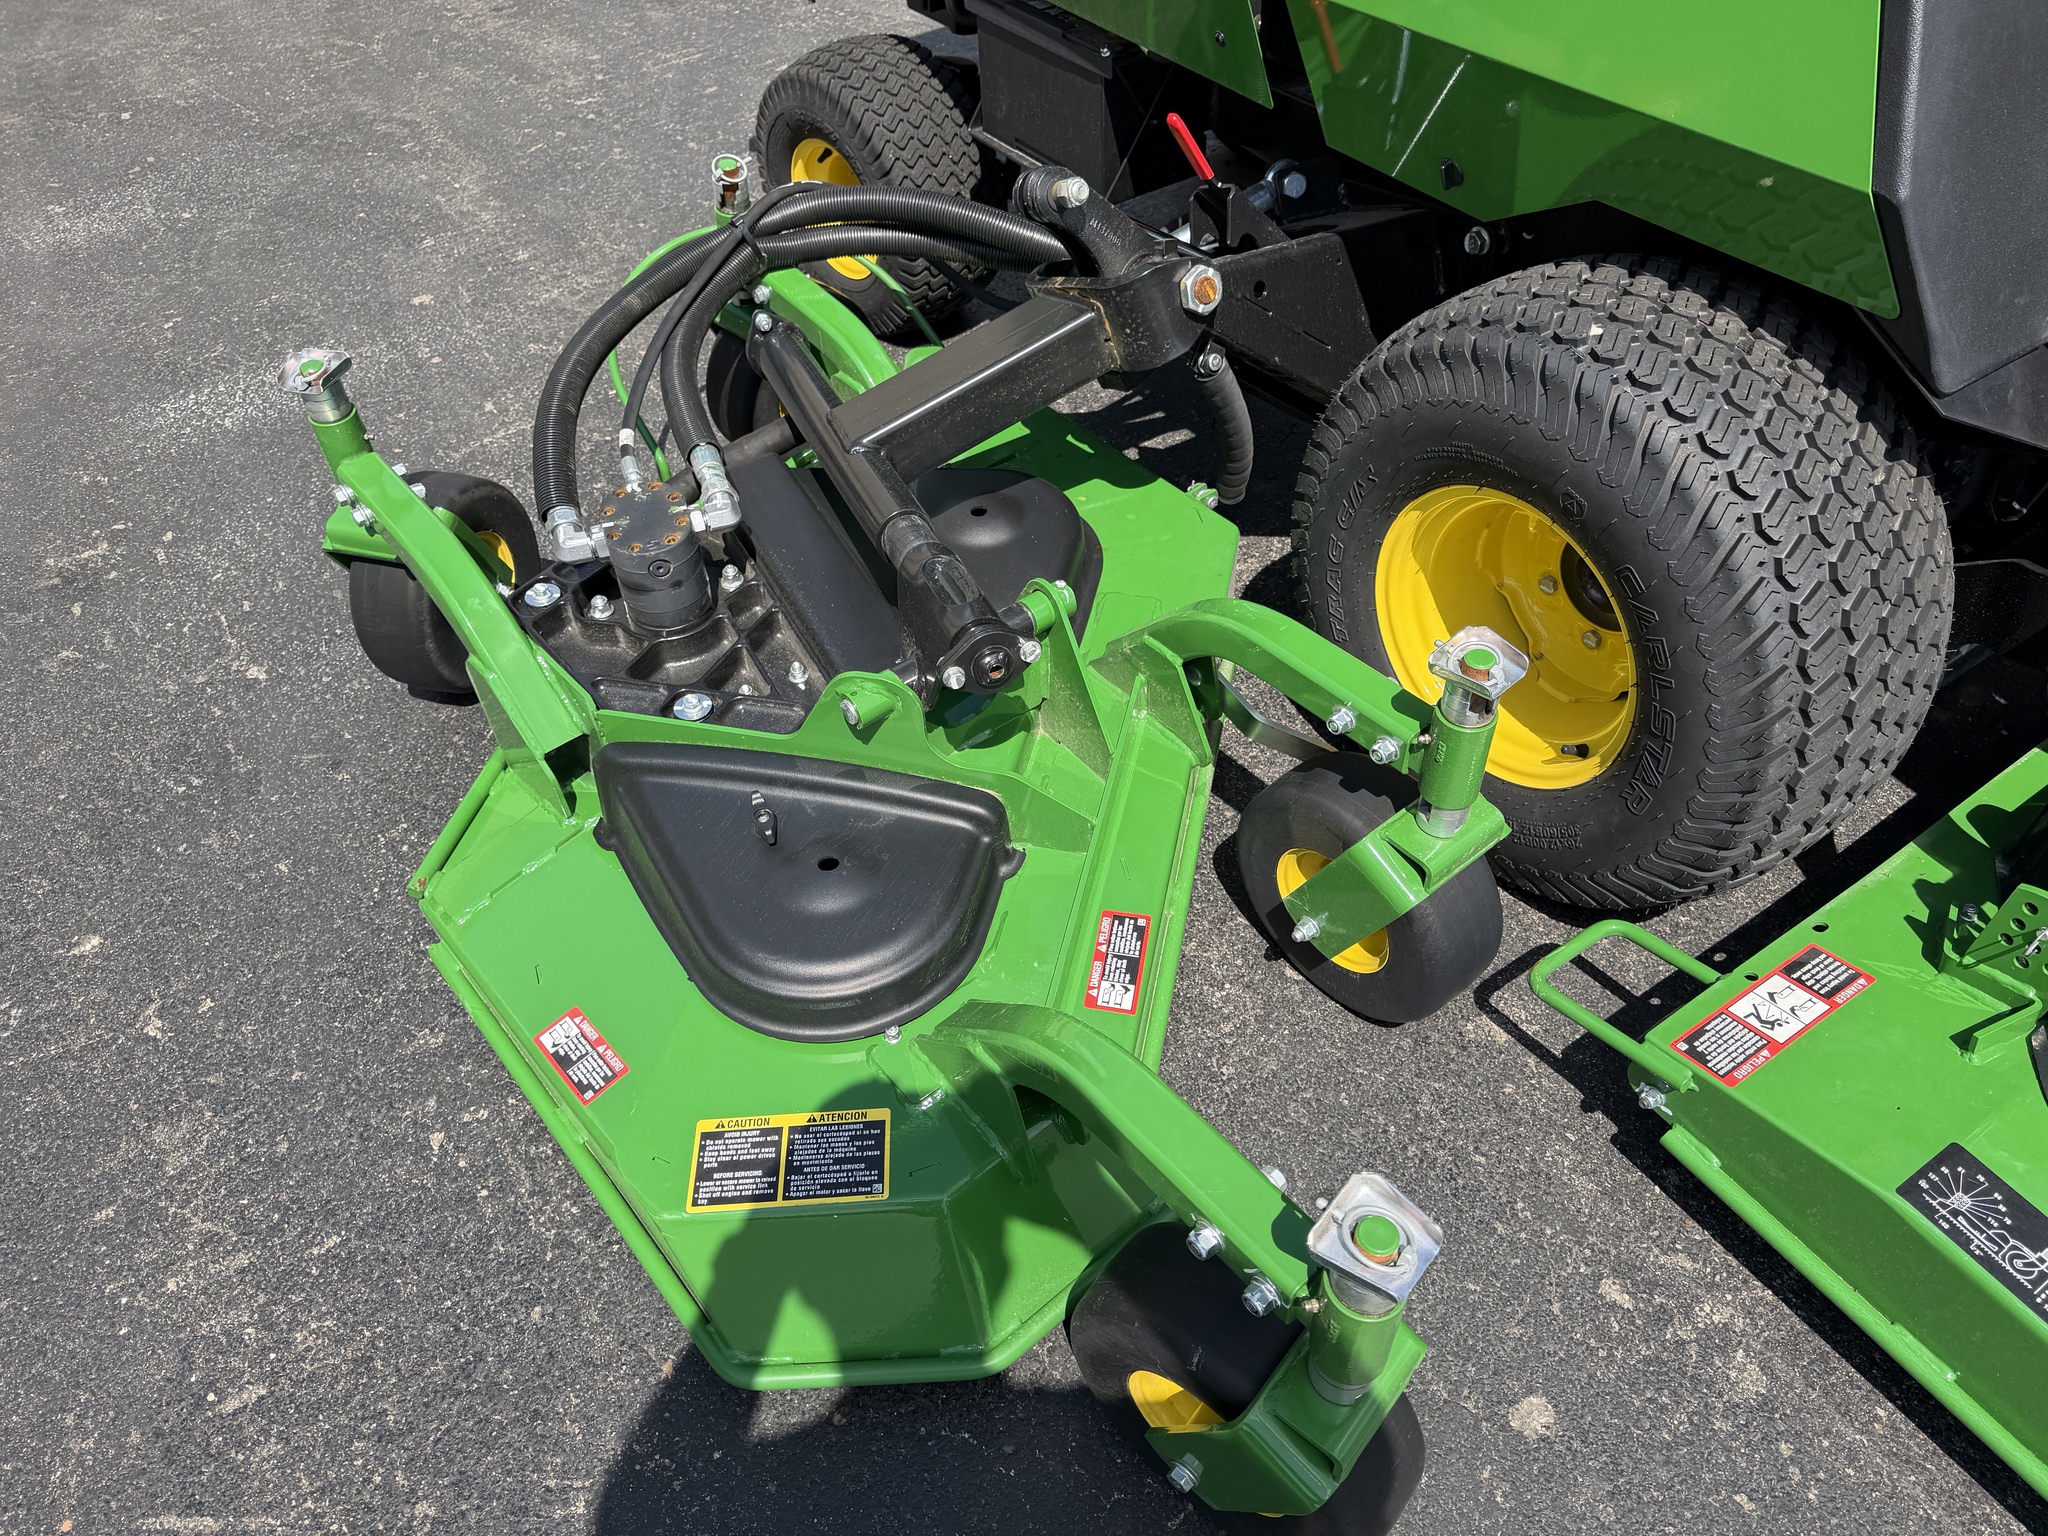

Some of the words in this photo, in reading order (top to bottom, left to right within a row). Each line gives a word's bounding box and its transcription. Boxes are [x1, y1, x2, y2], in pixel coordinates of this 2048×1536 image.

[1326, 533, 1350, 643] TRAC
[1614, 564, 1677, 816] CARLSTAR
[1099, 917, 1111, 943] PELIGRO
[1090, 960, 1102, 987] DANGER
[1833, 983, 1863, 1004] DANGER
[579, 1020, 599, 1042] DANGER
[603, 1048, 625, 1072] PELIGRO
[1732, 1055, 1766, 1079] PELIGRO
[727, 1118, 770, 1128] CAUTION
[819, 1111, 867, 1122] ATENCION
